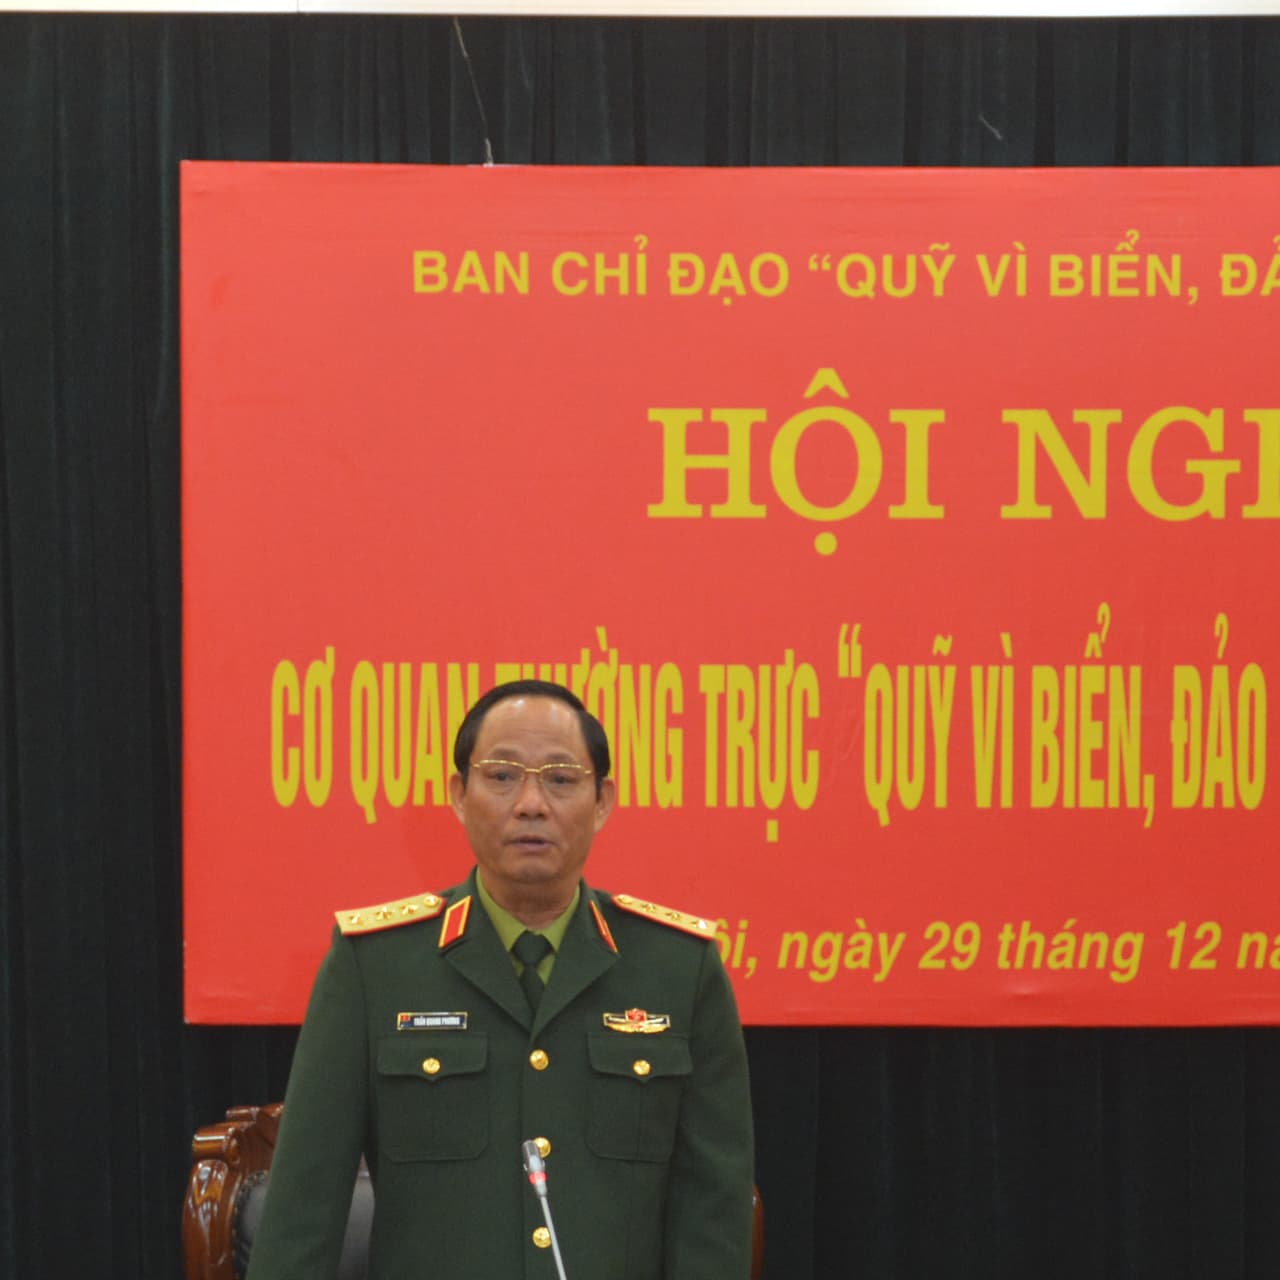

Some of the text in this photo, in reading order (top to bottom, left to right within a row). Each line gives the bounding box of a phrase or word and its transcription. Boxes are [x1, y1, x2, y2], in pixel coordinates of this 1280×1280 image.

[412, 249, 530, 295] BAN
[551, 233, 649, 297] CHỈ
[666, 251, 790, 306] ĐẠO
[807, 242, 957, 299] “QUỸ
[975, 240, 1028, 298] VÌ
[1049, 228, 1199, 305] BIỂN,
[646, 367, 946, 556] HỘI
[271, 645, 336, 808] CƠ
[494, 625, 684, 809] ỜNG
[698, 648, 820, 843] TRỰC
[837, 623, 957, 827] “QUỸ
[970, 632, 1015, 809] VÌ
[1030, 602, 1155, 828] BIỂN,
[1170, 612, 1267, 810] ĐẢO
[777, 918, 906, 983] ngày
[918, 921, 981, 971] 29
[997, 918, 1144, 983] tháng
[1167, 921, 1222, 969] 12
